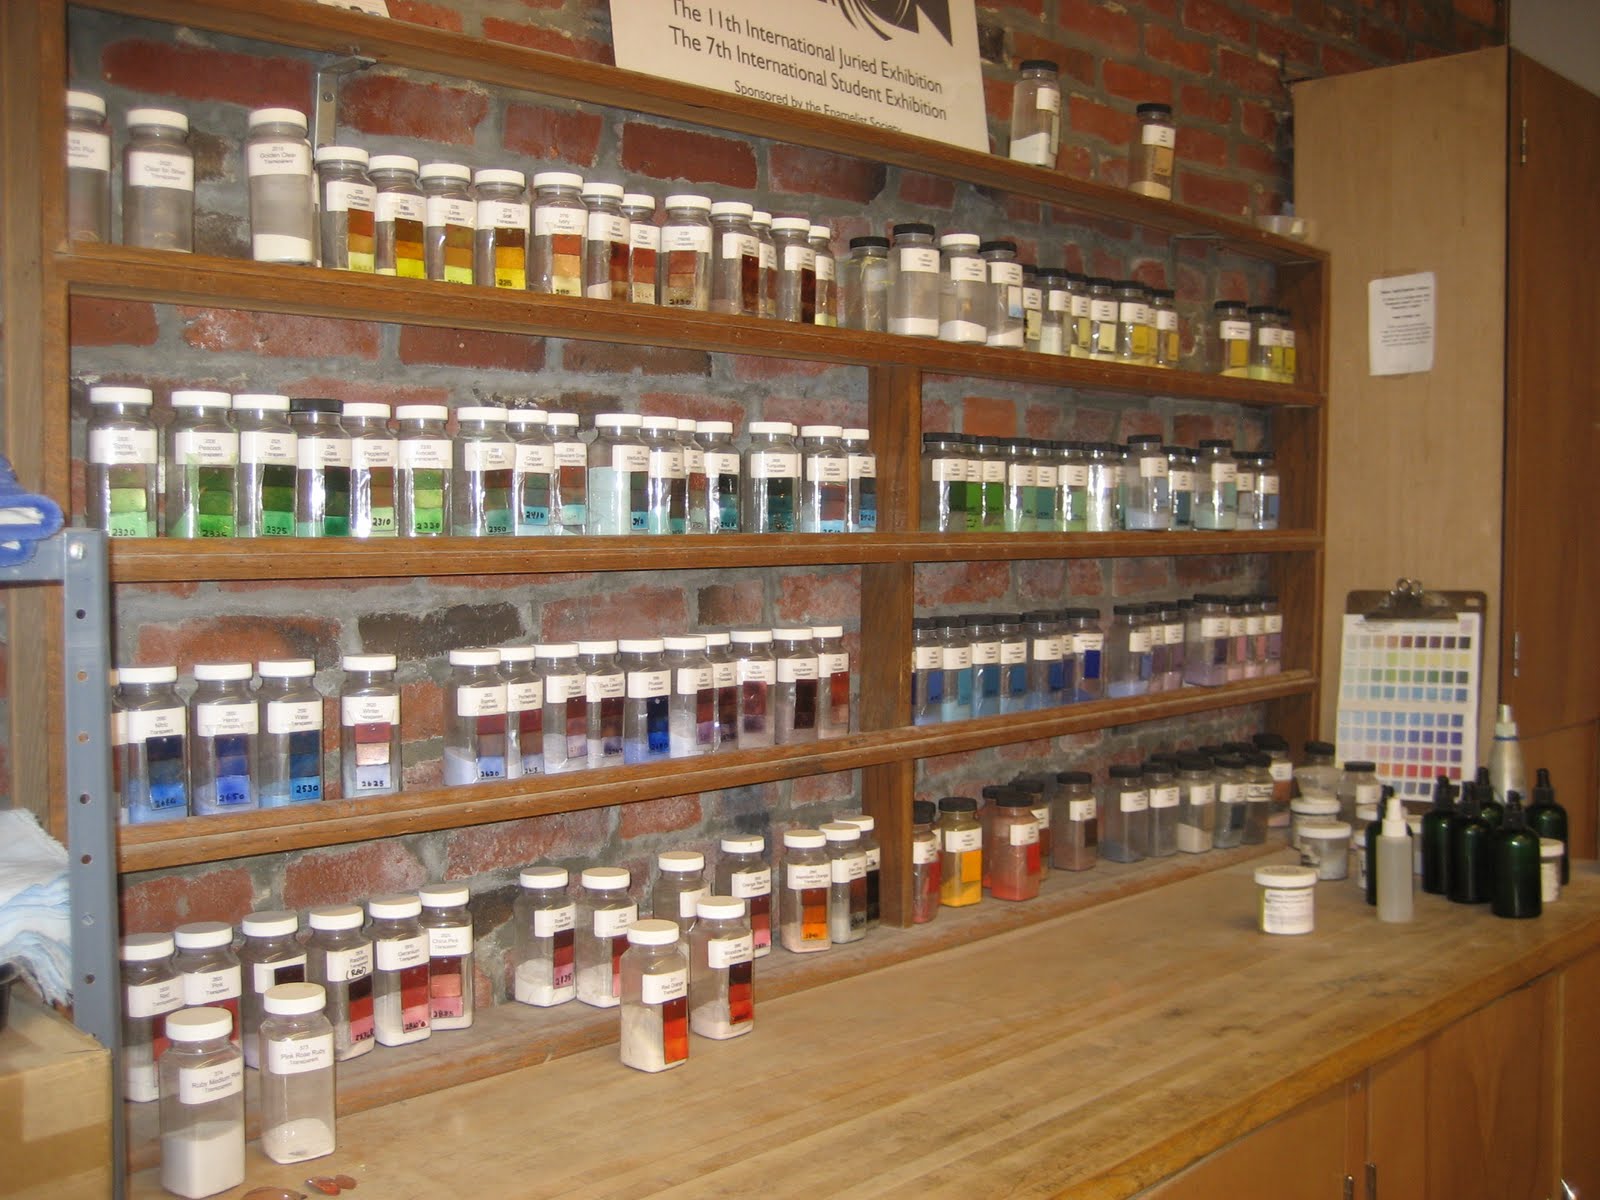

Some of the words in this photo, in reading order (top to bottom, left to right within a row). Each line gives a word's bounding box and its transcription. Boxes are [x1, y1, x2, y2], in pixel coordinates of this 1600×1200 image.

[672, 0, 701, 22] The
[709, 6, 741, 34] 11th
[746, 19, 835, 62] International
[839, 47, 877, 75] Juried
[881, 61, 943, 95] Exhibition
[669, 25, 701, 52] The
[706, 35, 732, 61] 7th
[737, 44, 827, 88] International
[831, 72, 882, 104] Student
[886, 86, 947, 121] Exhibition
[734, 80, 788, 106] Sponsored
[791, 95, 803, 109] by
[805, 100, 821, 112] the
[373, 517, 391, 526] 2310
[112, 528, 136, 536] 2320
[266, 526, 288, 535] 2325
[296, 785, 319, 793] 2530
[219, 793, 245, 801] 2650
[295, 1050, 311, 1058] Rose
[311, 1048, 325, 1056] Ruby
[192, 1080, 208, 1089] Ruby
[209, 1074, 230, 1085] Medium
